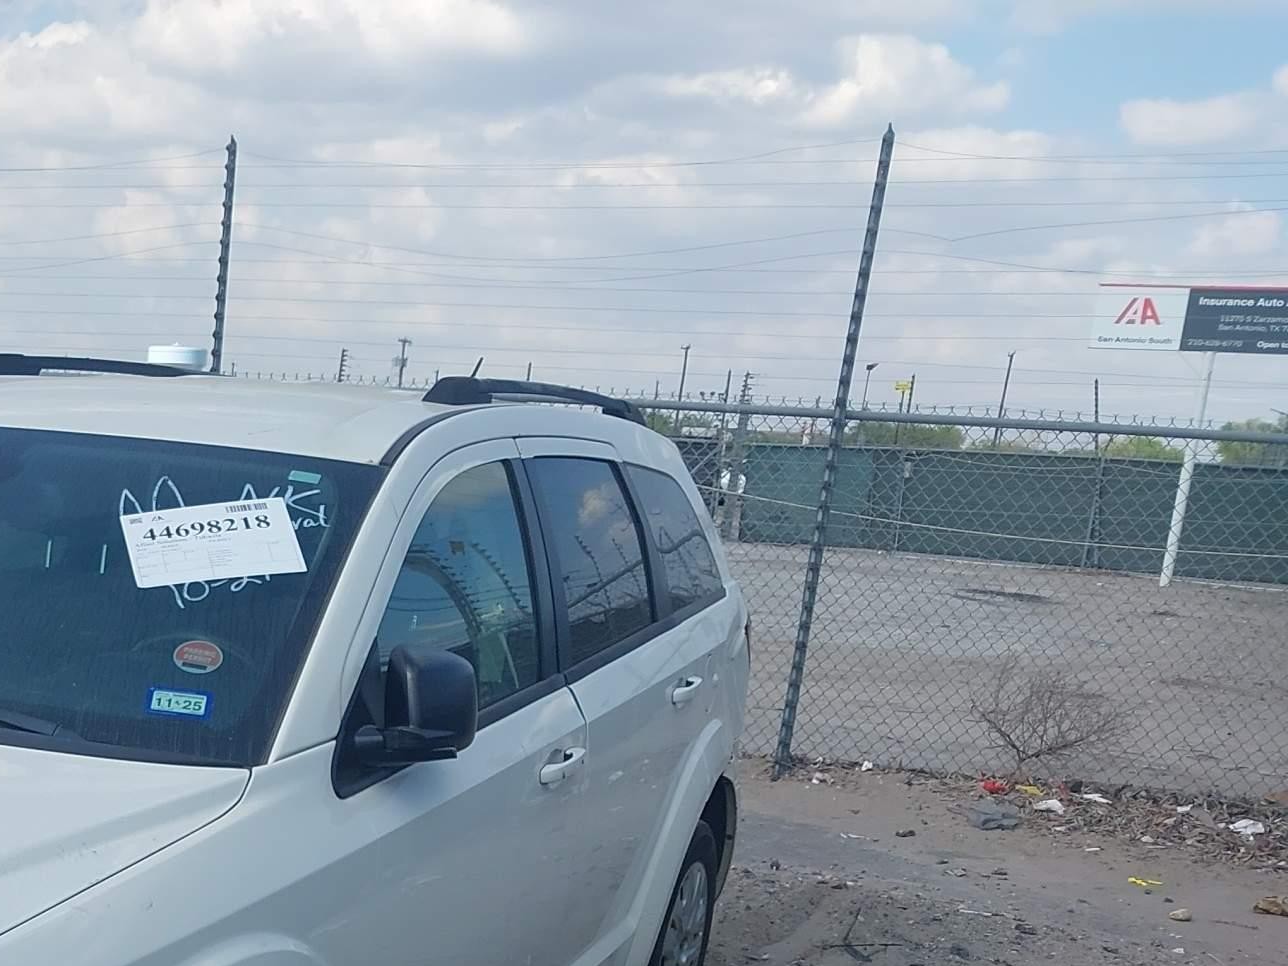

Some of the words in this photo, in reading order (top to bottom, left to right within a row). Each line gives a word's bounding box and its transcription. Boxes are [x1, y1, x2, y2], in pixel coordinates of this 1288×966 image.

[1198, 296, 1256, 307] Insurance
[1256, 298, 1285, 307] Auto
[1114, 336, 1147, 344] Antonio
[1148, 337, 1174, 345] South
[1256, 341, 1279, 349] Open
[143, 514, 272, 541] 44698218
